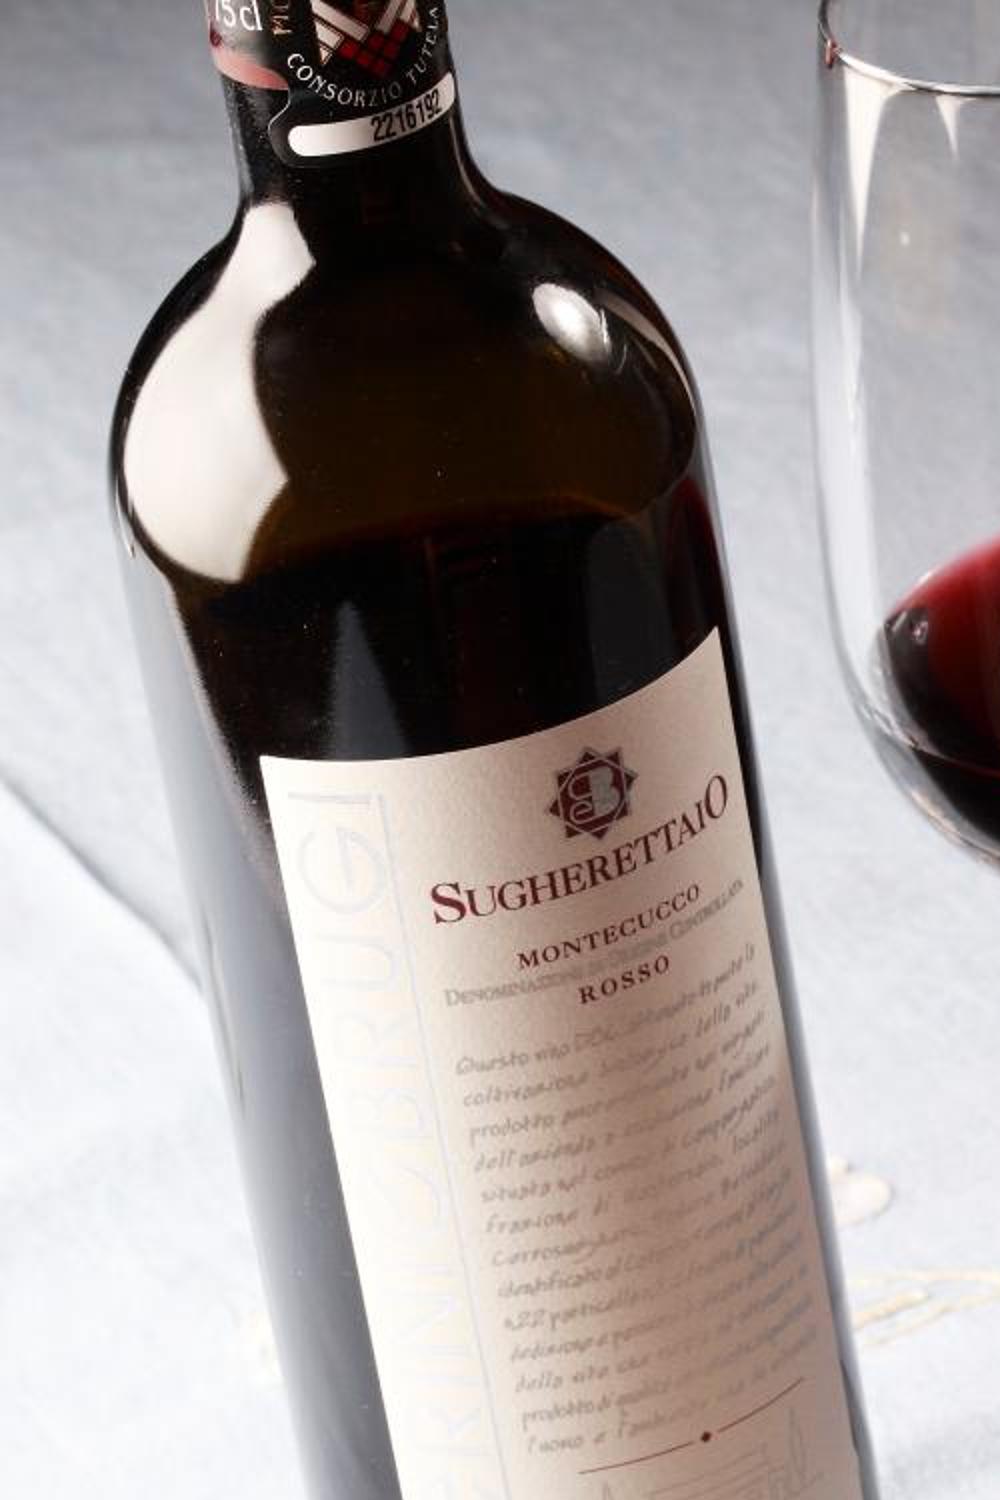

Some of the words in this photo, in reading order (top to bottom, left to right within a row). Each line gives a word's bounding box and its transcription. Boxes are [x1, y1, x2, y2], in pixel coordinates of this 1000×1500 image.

[287, 53, 402, 107] CONSORZIO
[406, 8, 441, 84] TUTELA
[371, 88, 443, 142] 2216192
[430, 775, 728, 924] SUGHERETTAIO
[516, 884, 701, 970] MONTECUCCO
[579, 955, 670, 1005] ROSSO
